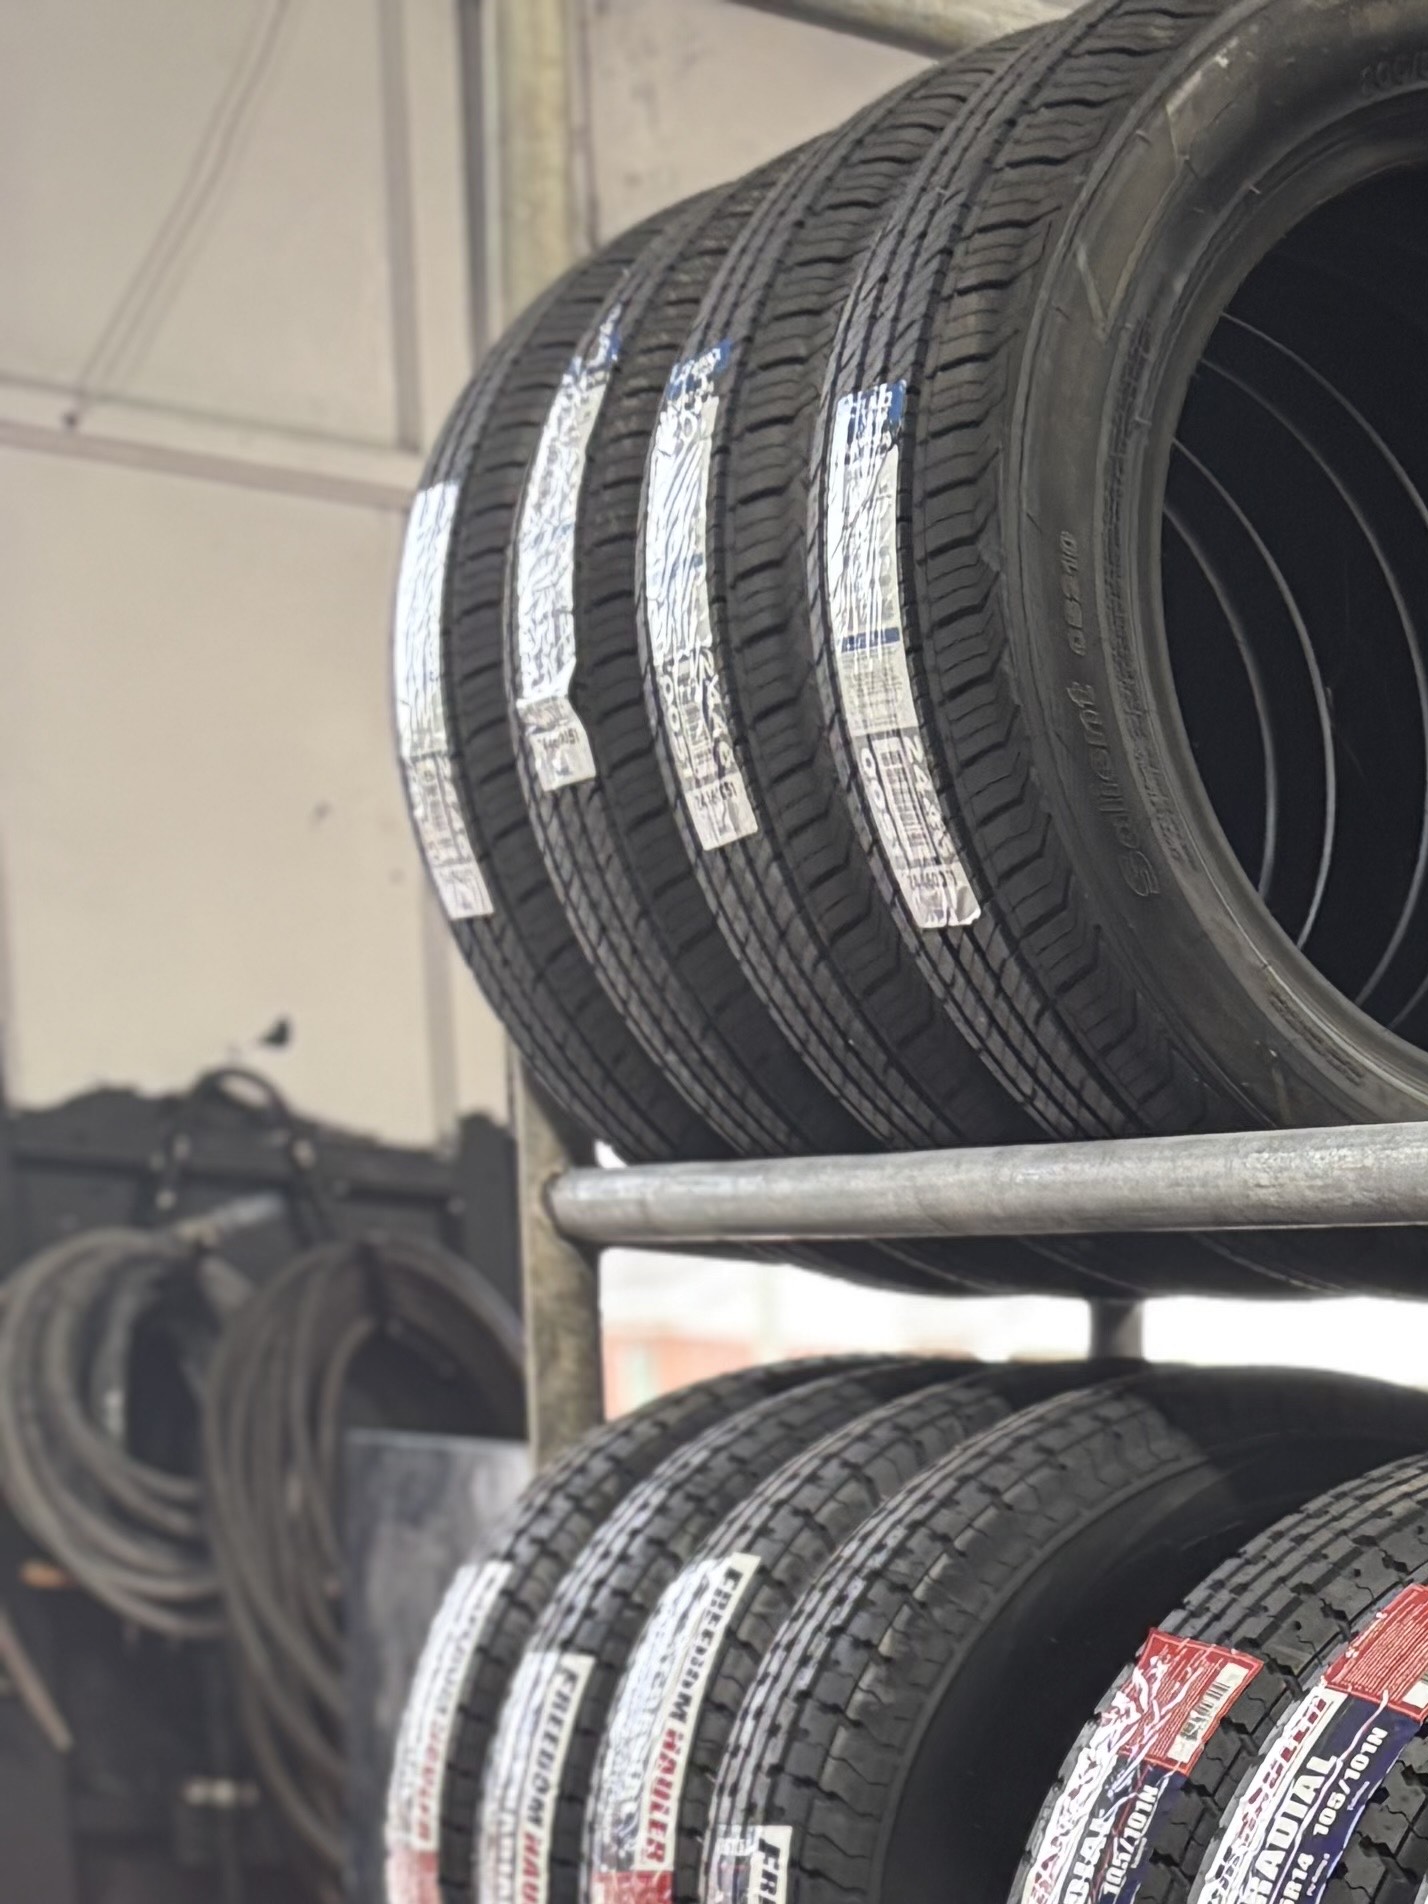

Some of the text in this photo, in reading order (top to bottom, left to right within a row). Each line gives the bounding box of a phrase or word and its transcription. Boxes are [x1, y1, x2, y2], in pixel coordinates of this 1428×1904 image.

[647, 1726, 687, 1864] HAULER
[1314, 1728, 1387, 1835] 105/101N
[1103, 1784, 1159, 1896] 105/101N
